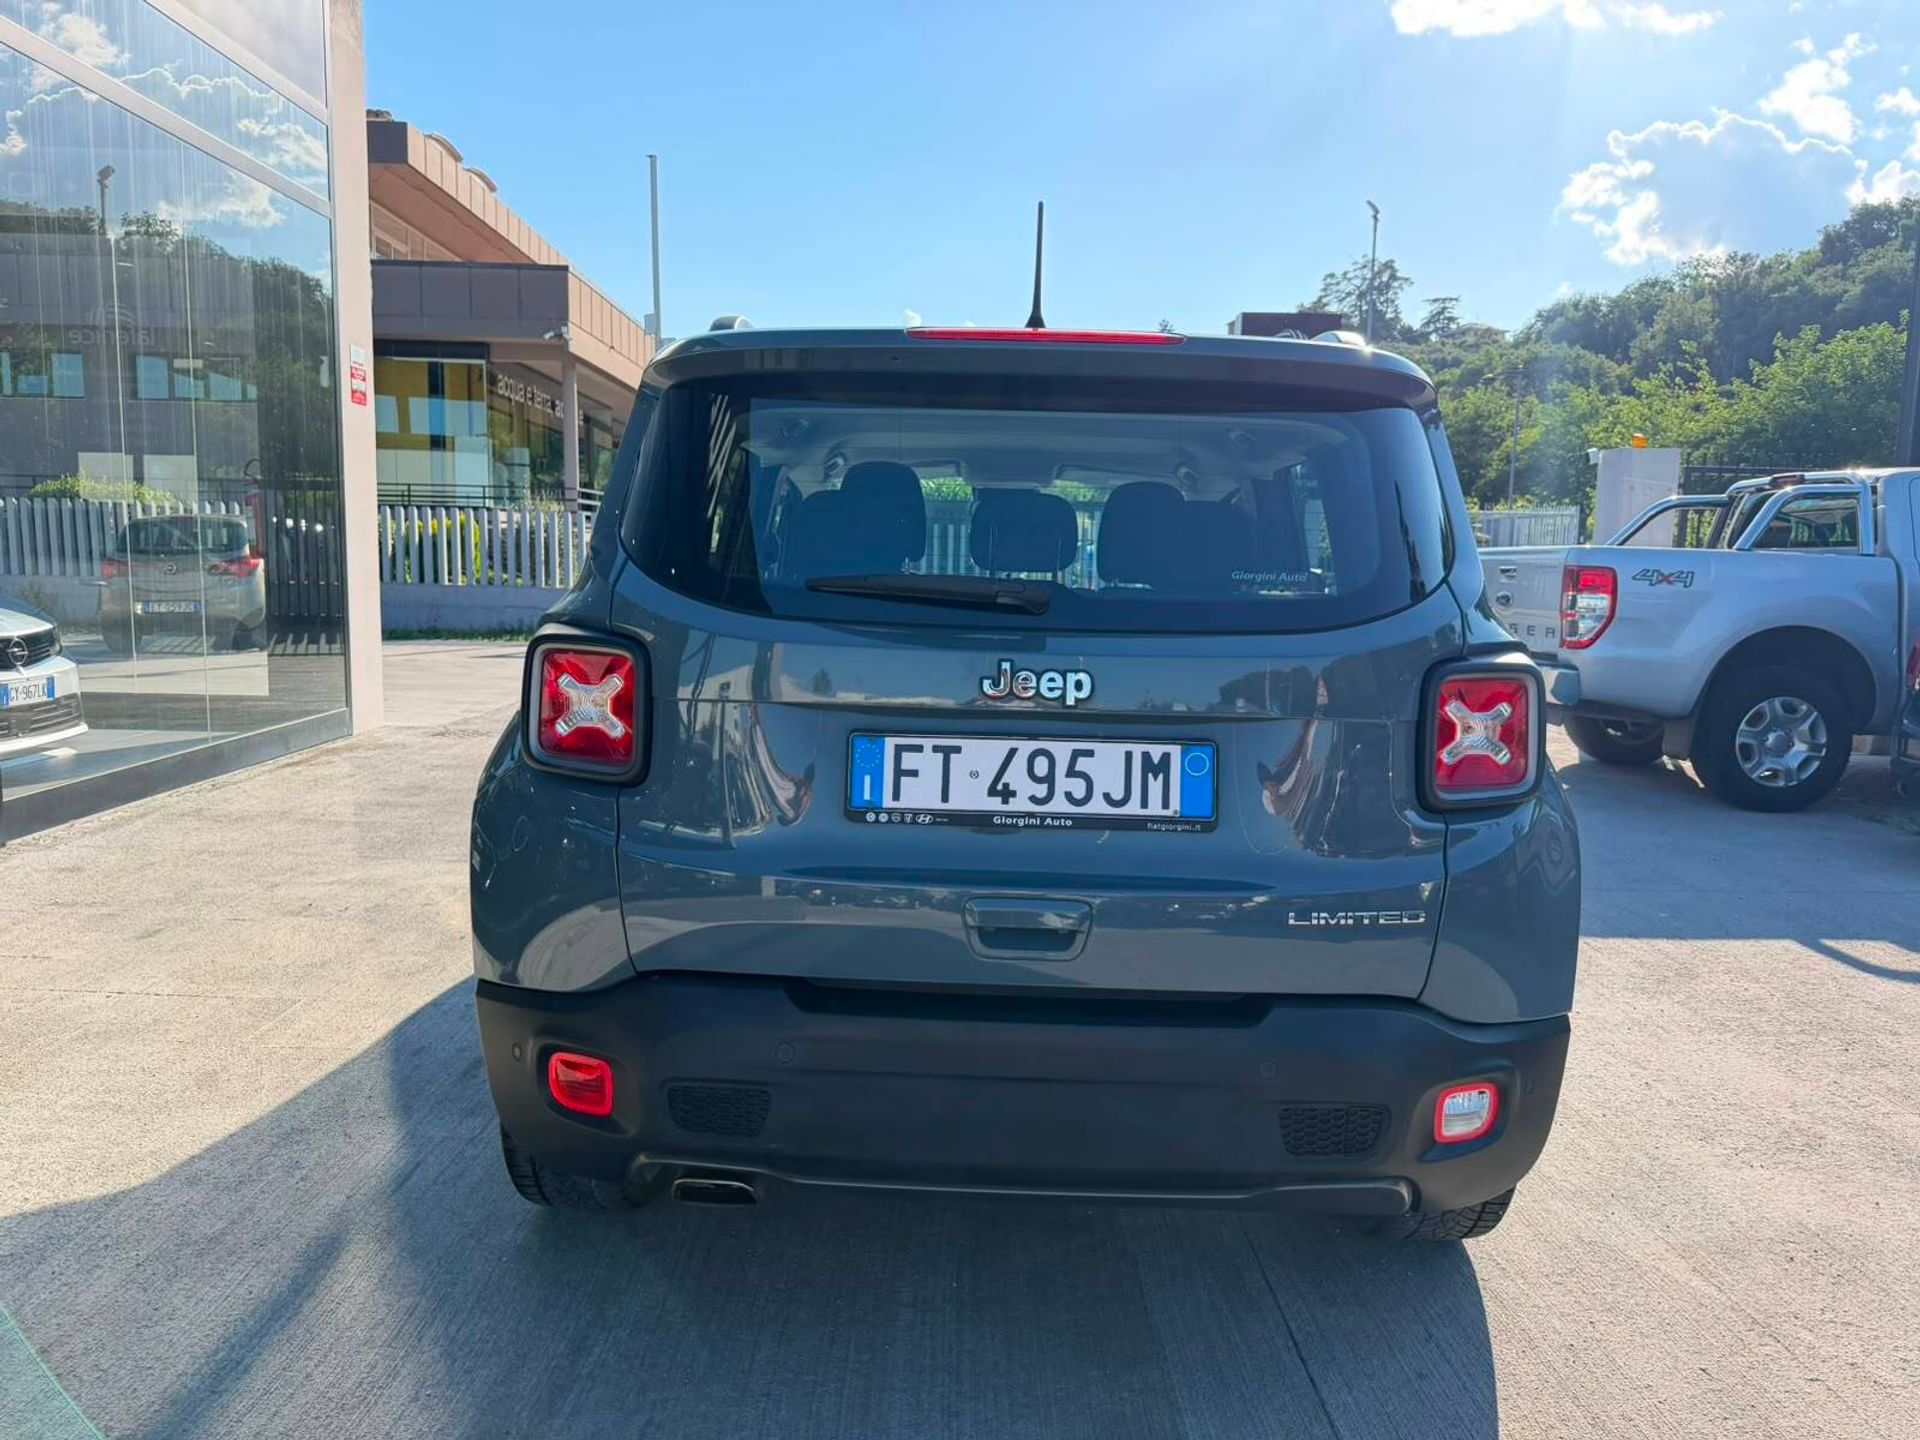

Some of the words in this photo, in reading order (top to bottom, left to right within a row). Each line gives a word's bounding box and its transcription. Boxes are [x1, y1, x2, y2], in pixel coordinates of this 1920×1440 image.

[497, 374, 525, 406] acqua
[526, 386, 533, 406] e
[1232, 570, 1277, 582] Giorgini
[1279, 572, 1307, 582] Auto
[980, 658, 1092, 706] Jeep
[892, 744, 962, 803] FT
[987, 747, 1171, 810] 495JM
[992, 816, 1041, 827] Giorgini
[1044, 817, 1073, 826] Auto
[1288, 911, 1426, 925] LIMITED
